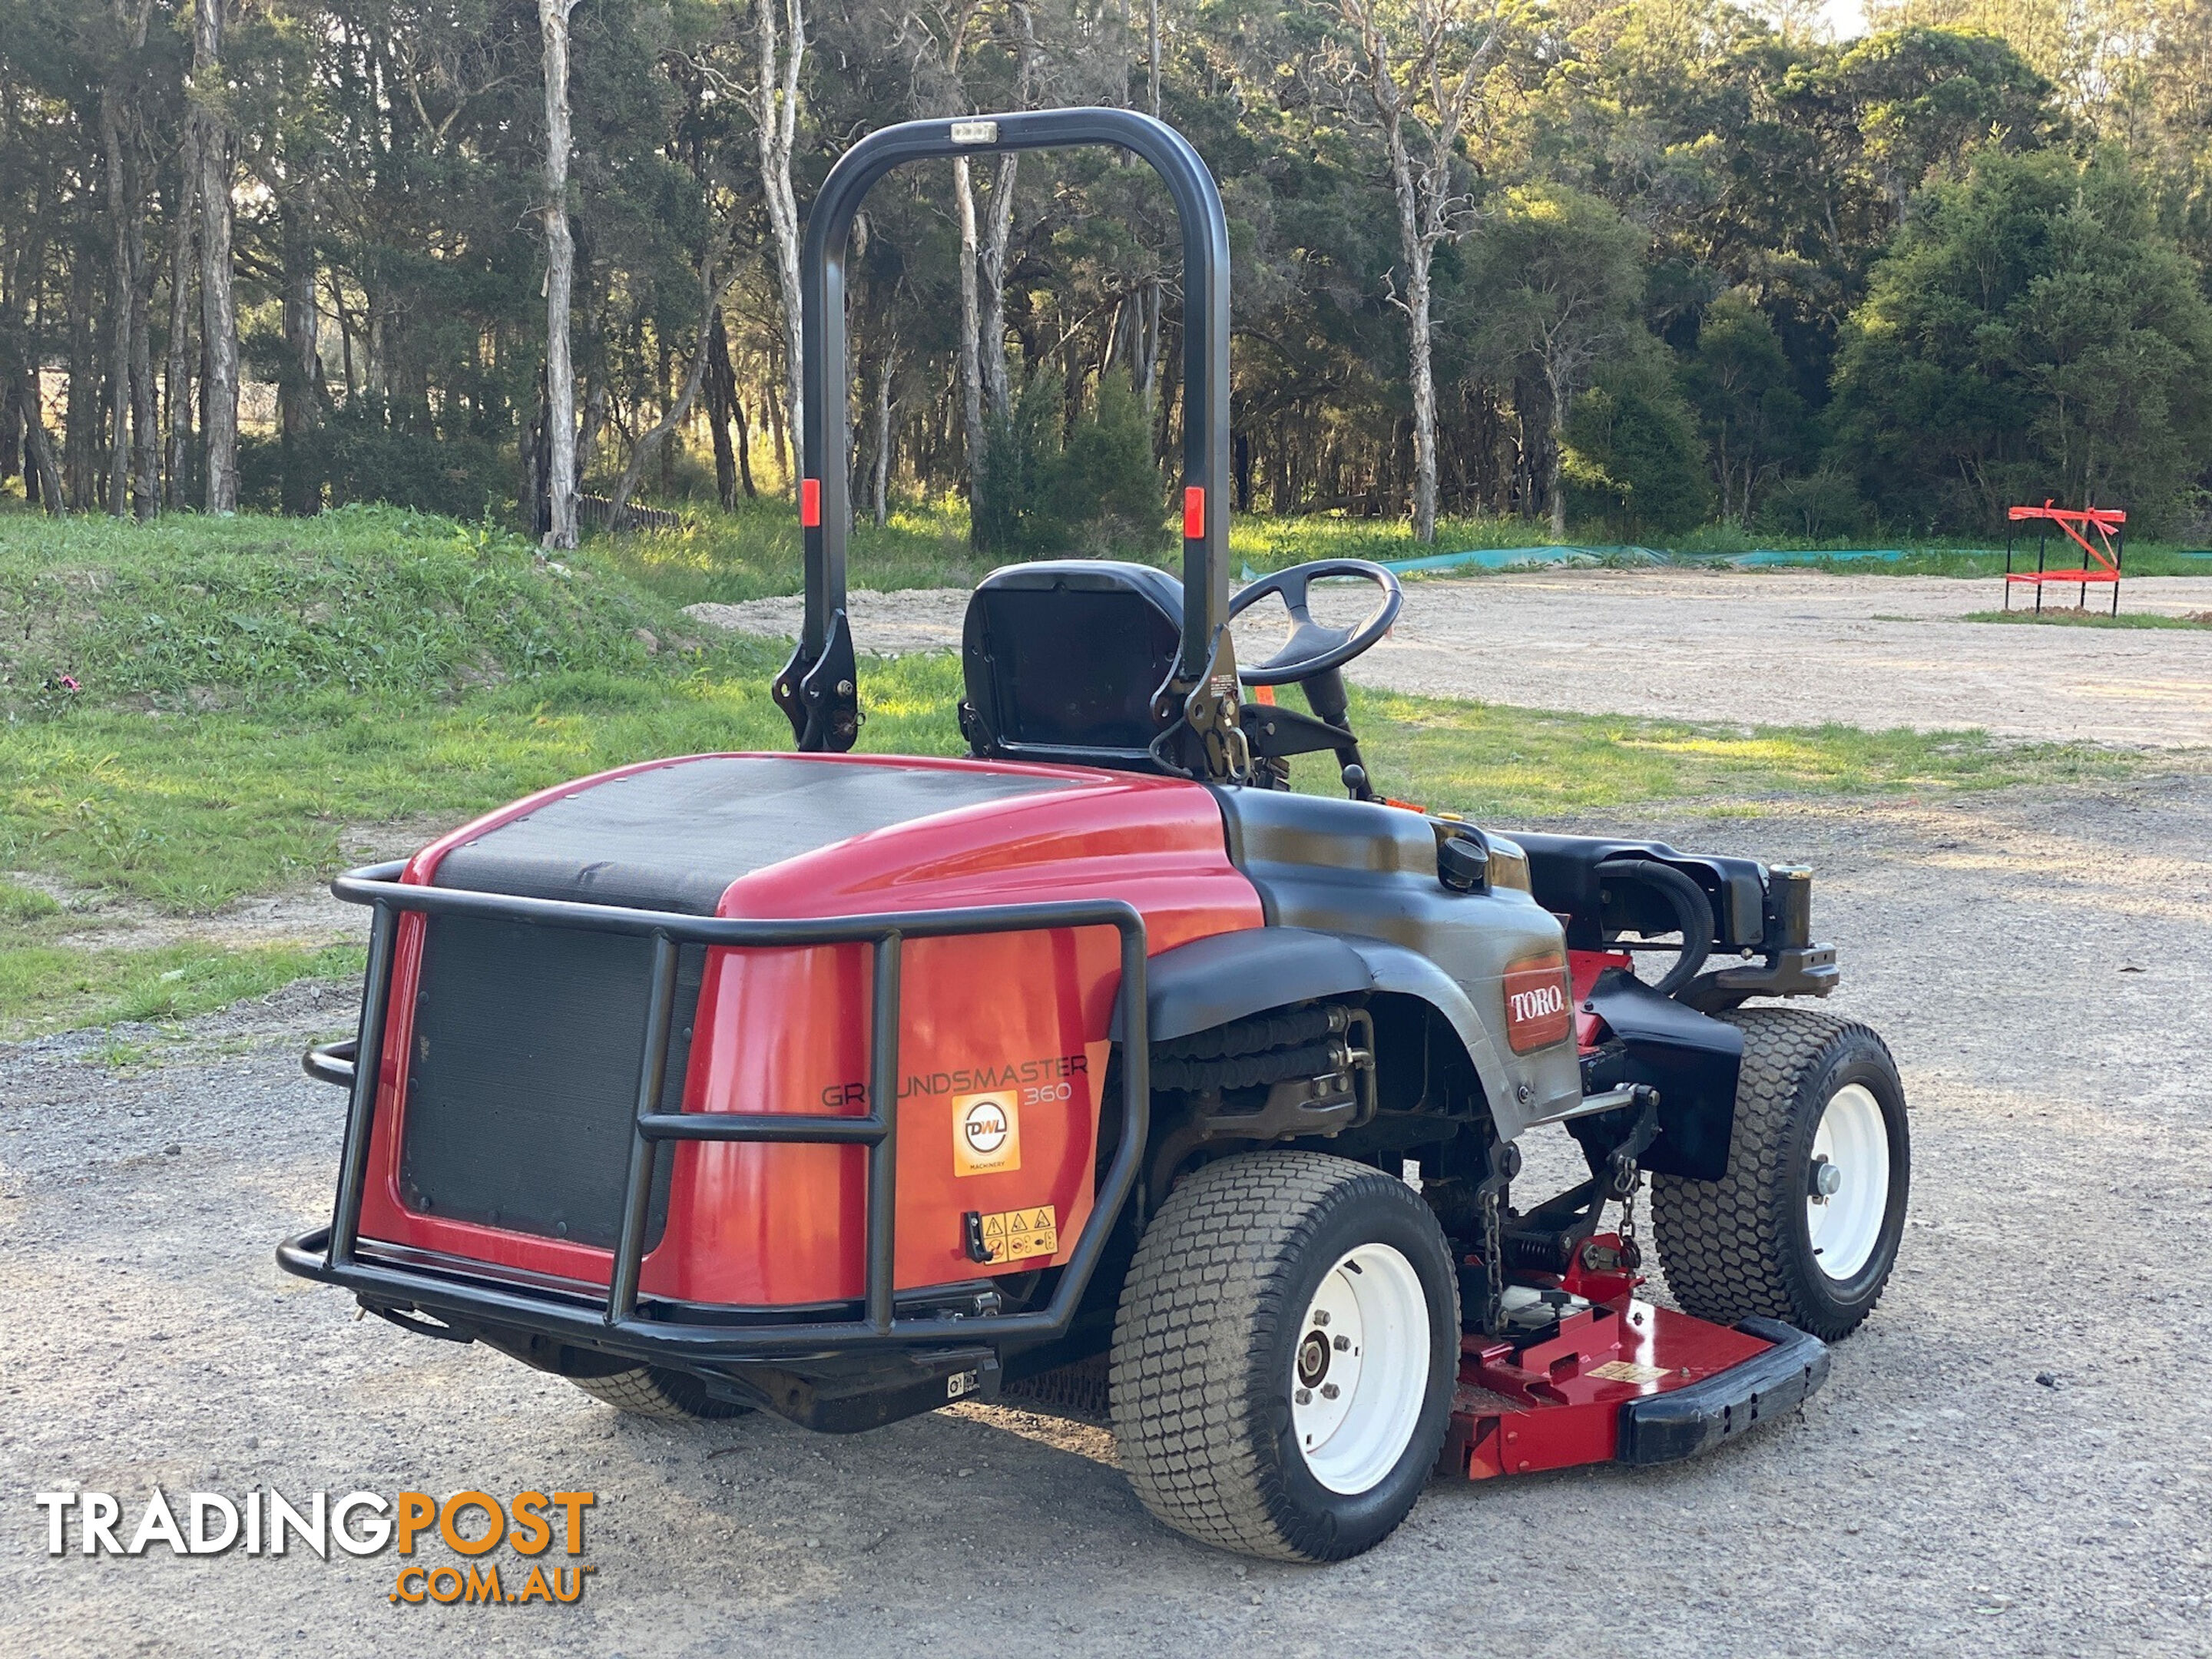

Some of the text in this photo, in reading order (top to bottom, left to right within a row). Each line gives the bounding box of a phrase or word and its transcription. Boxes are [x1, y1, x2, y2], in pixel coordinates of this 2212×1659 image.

[821, 1054, 1088, 1107] GRUNDSMASTER
[1023, 1081, 1072, 1106] 360
[965, 1119, 1007, 1136] DWL
[970, 1161, 1005, 1171] MACHINERY
